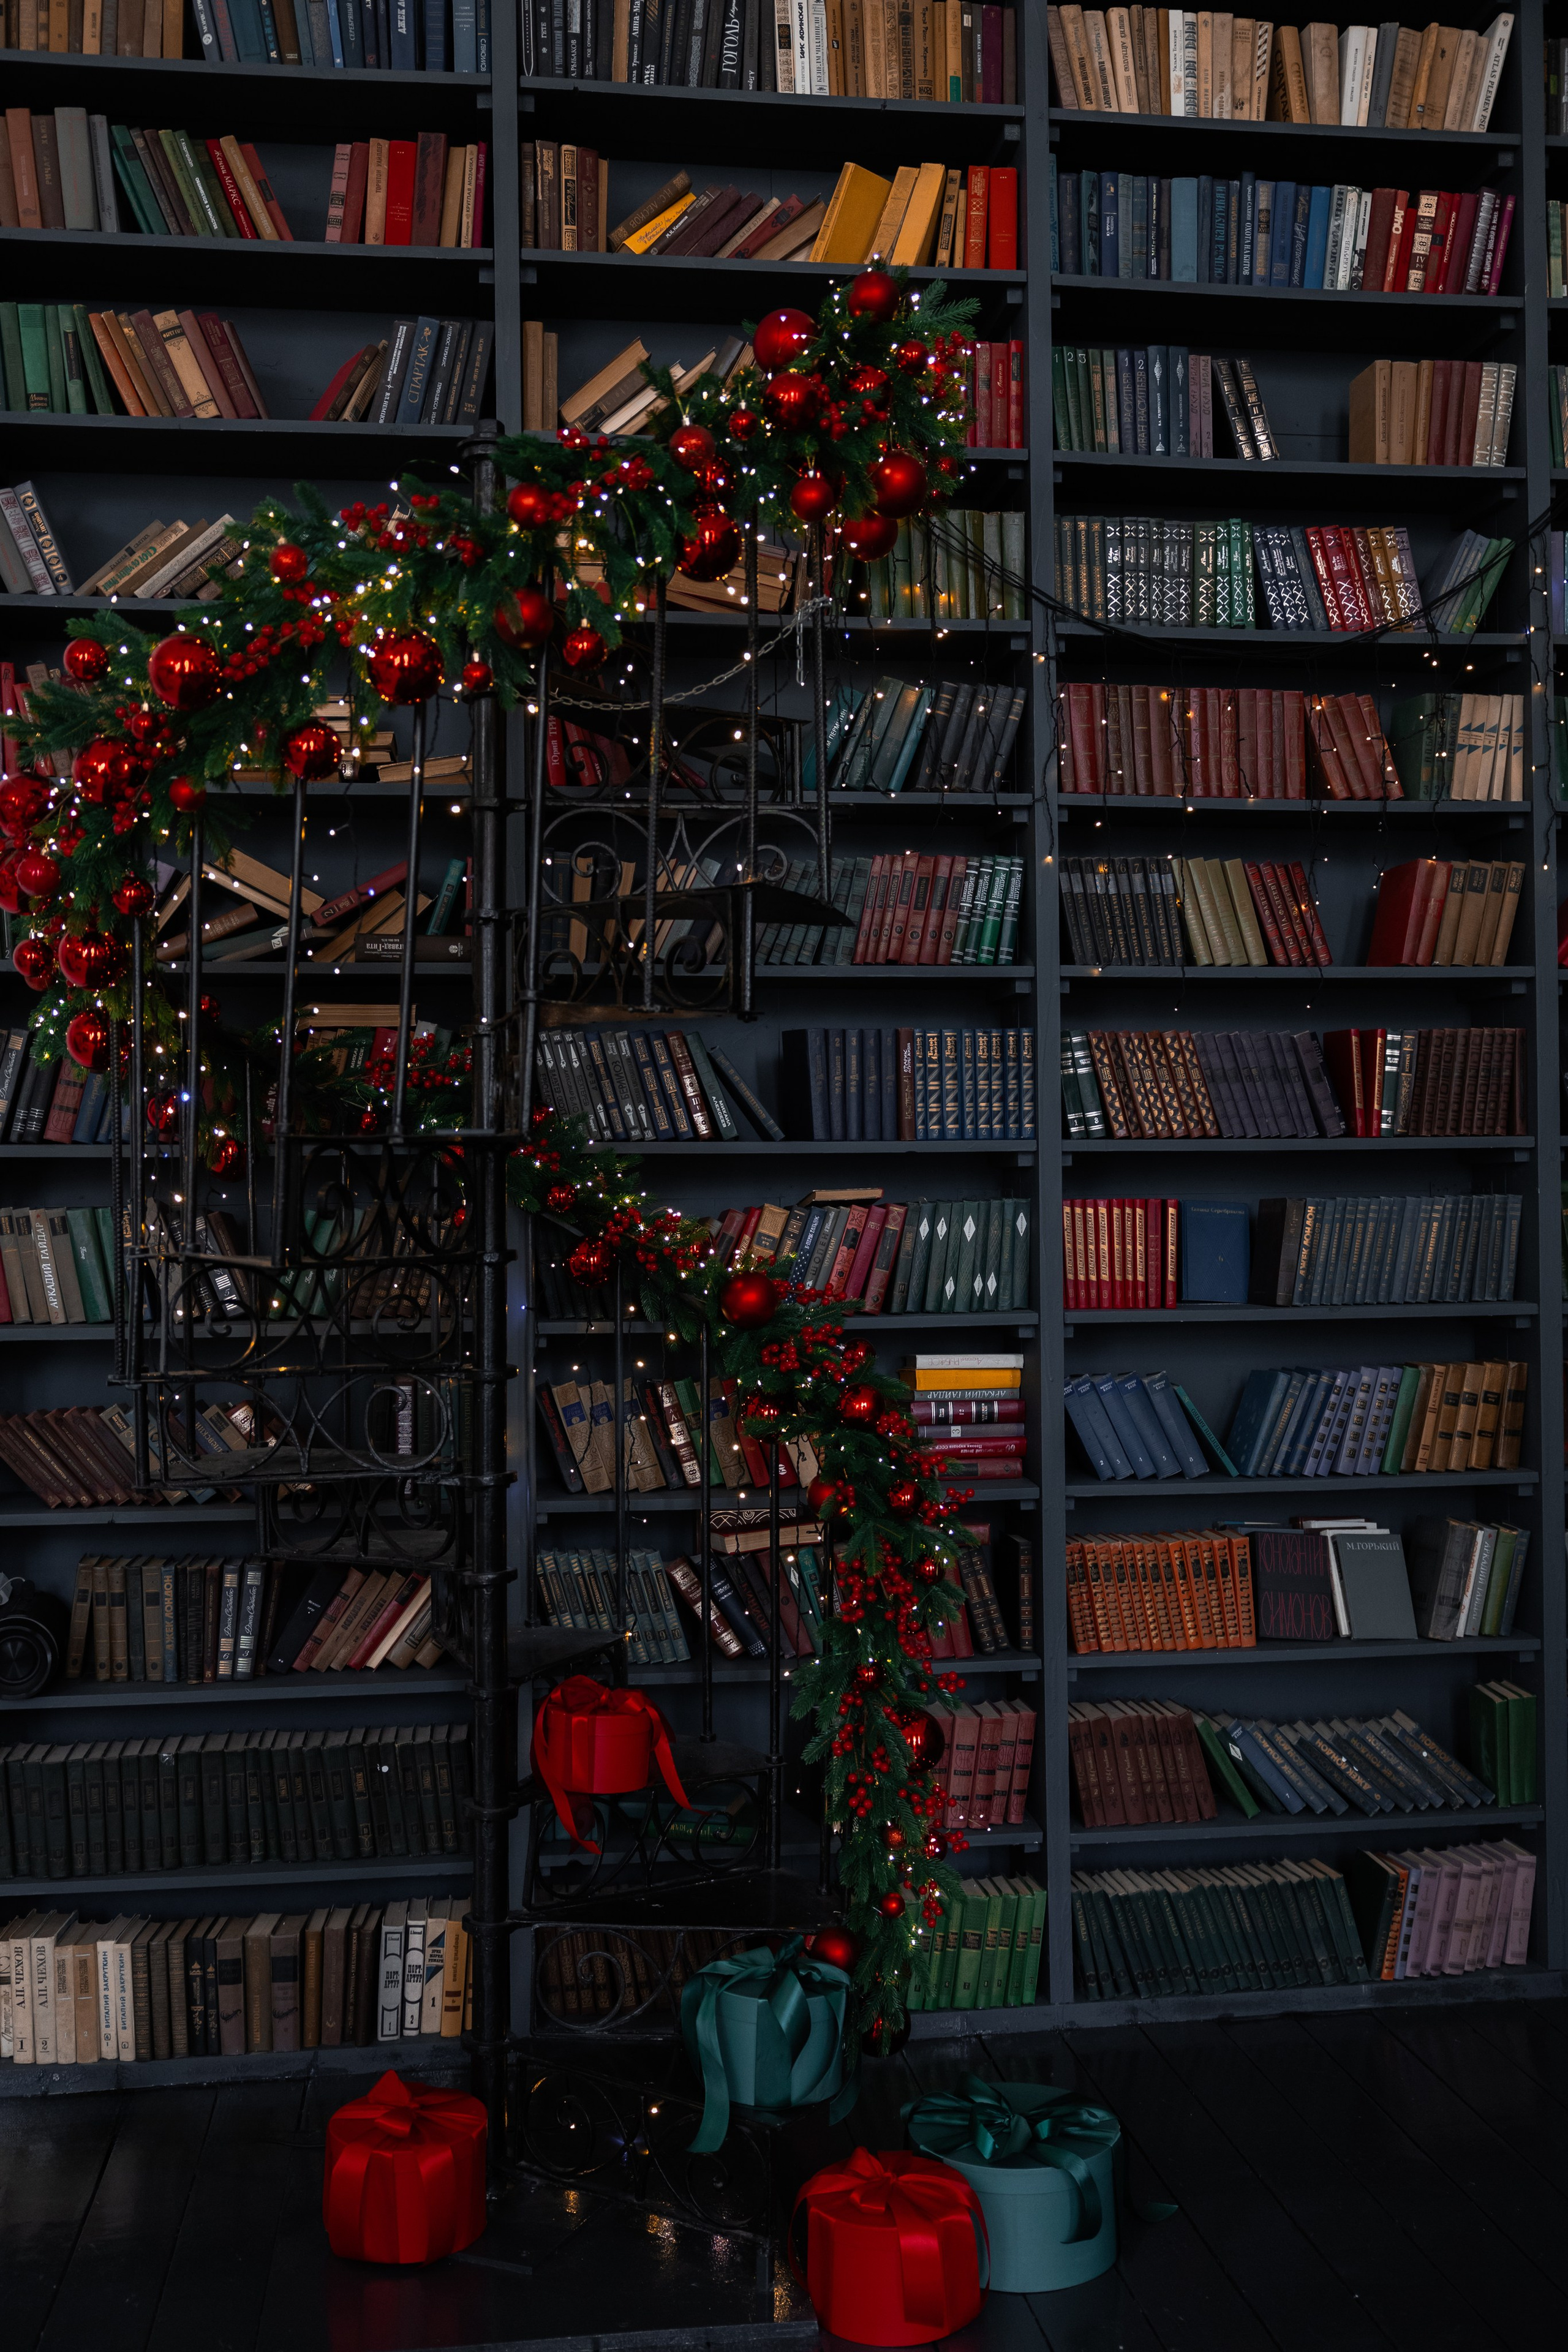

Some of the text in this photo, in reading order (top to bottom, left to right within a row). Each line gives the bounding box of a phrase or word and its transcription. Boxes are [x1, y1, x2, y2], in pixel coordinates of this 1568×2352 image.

[720, 18, 741, 74] ГОГОЛЬ
[1490, 53, 1501, 79] ATLAS
[1482, 80, 1495, 113] PLEMEN
[223, 174, 241, 206] МАРКС
[1392, 205, 1405, 234] ОЧАГ
[407, 343, 428, 404] СПАРТАК
[1135, 371, 1147, 421] ВАСИЛЬЕВ
[963, 876, 977, 902] ШУНДИК
[979, 874, 990, 900] ШУНДИК
[997, 873, 1006, 899] ШУНДИК
[1012, 873, 1022, 899] ШУНДИК
[1256, 885, 1271, 916] ФАДЕЕВ
[1270, 884, 1284, 914] ФАДЕЕВ
[712, 1095, 726, 1128] АЛЕКСЕЕВ
[718, 1100, 731, 1126] МИХАИЛ
[1302, 1205, 1316, 1246] ЛОНДОН
[35, 1221, 58, 1309] АРКАДИЙ ГАЙДАР
[1204, 1427, 1225, 1458] ВАЛЕНТИН
[164, 1575, 173, 1649] ДЖЕК ЛОНДОН
[15, 1947, 24, 2008] А.П. ЧЕХОВ
[37, 1946, 47, 2008] А.П. ЧЕХОВ
